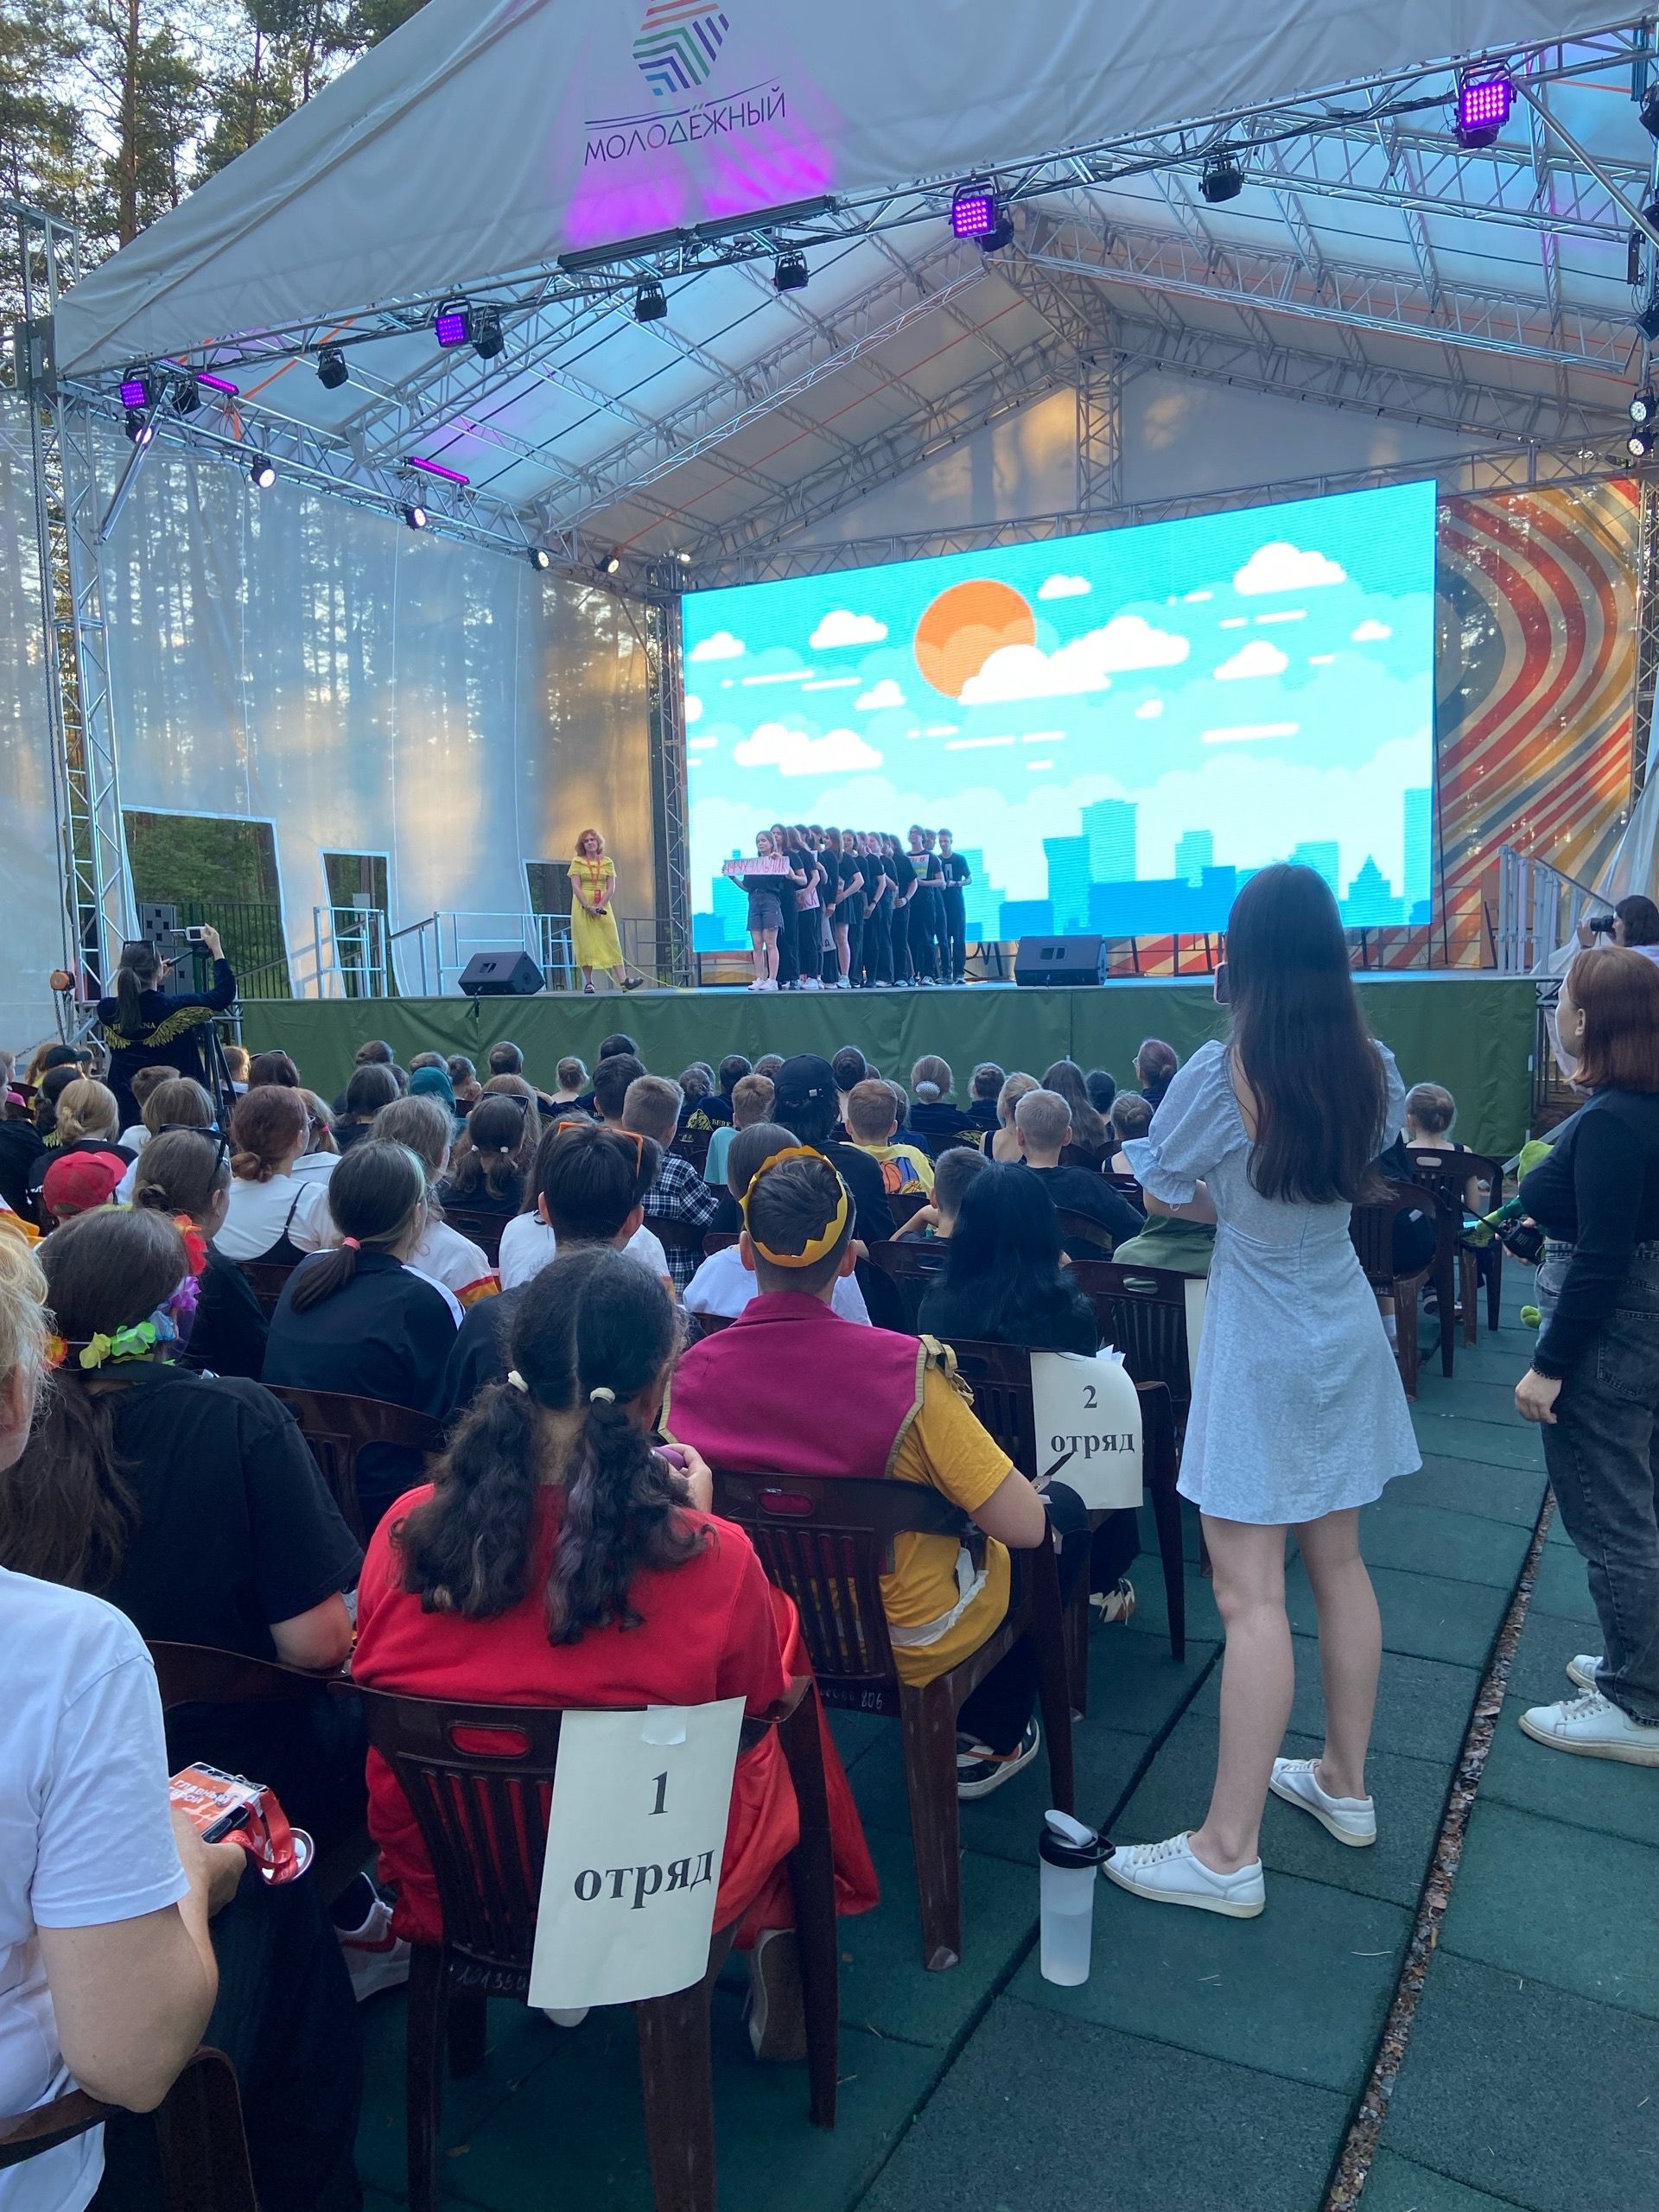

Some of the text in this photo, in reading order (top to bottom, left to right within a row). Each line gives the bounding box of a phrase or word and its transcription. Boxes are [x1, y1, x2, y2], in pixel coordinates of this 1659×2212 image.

[584, 86, 785, 166] МОЛОДЁЖНЫЙ
[711, 1118, 732, 1127] BERK
[1082, 1384, 1098, 1408] 2
[1051, 1433, 1135, 1459] отряд
[647, 1771, 669, 1815] 1
[574, 1849, 715, 1909] отряд
